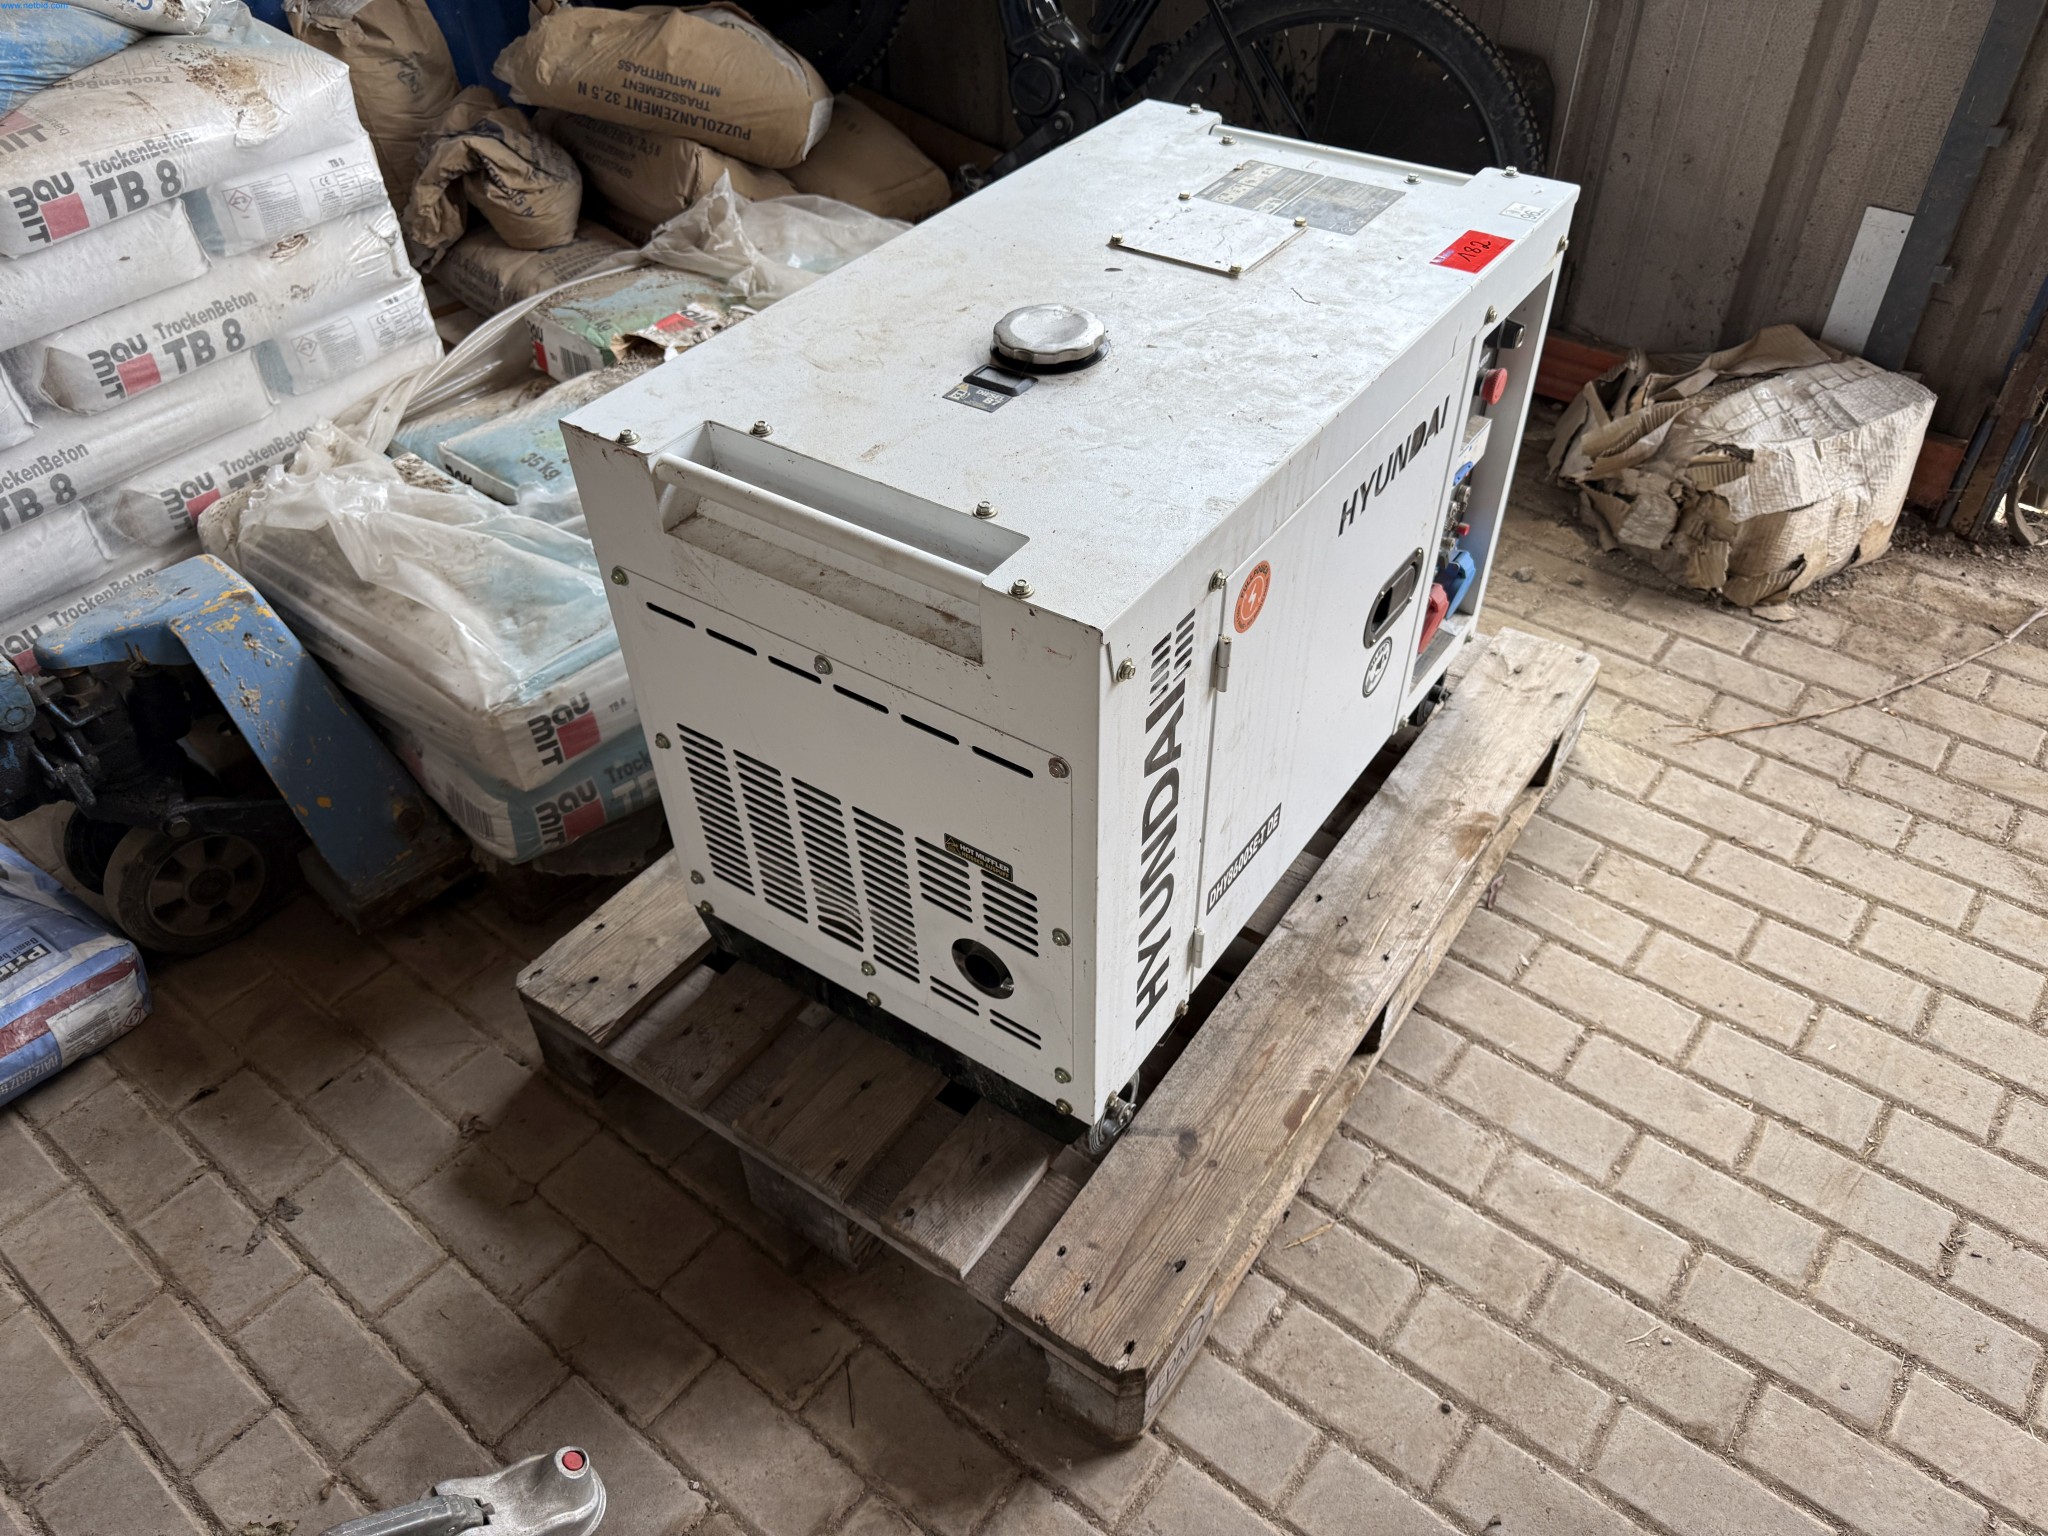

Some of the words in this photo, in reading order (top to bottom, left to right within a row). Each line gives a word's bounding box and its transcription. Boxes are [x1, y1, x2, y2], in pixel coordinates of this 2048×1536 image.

[577, 80, 588, 96] N
[617, 59, 697, 89] NATURTRASS
[698, 82, 721, 98] MIT
[592, 85, 622, 106] 32,5
[621, 78, 711, 112] TRASSZEMENT
[625, 96, 752, 141] PUZZOLANZEMENT
[79, 131, 193, 180] TrockenBeton
[90, 171, 150, 220] TB
[156, 160, 183, 198] 8
[1457, 240, 1491, 262] 182
[152, 290, 257, 341] TrockenBeton
[161, 330, 217, 374] TB
[222, 318, 246, 352] 8
[521, 452, 540, 468] 35
[539, 459, 562, 480] kg
[1338, 393, 1450, 537] HYUNDAI
[50, 473, 77, 506] 8
[960, 844, 975, 855] HOT
[975, 851, 1009, 873] MUFFLER
[984, 862, 1009, 878] AUSPUFF
[1135, 678, 1186, 1031] HYUNDAI
[1208, 825, 1266, 910] DHY8600SE-T
[1266, 808, 1280, 837] DE
